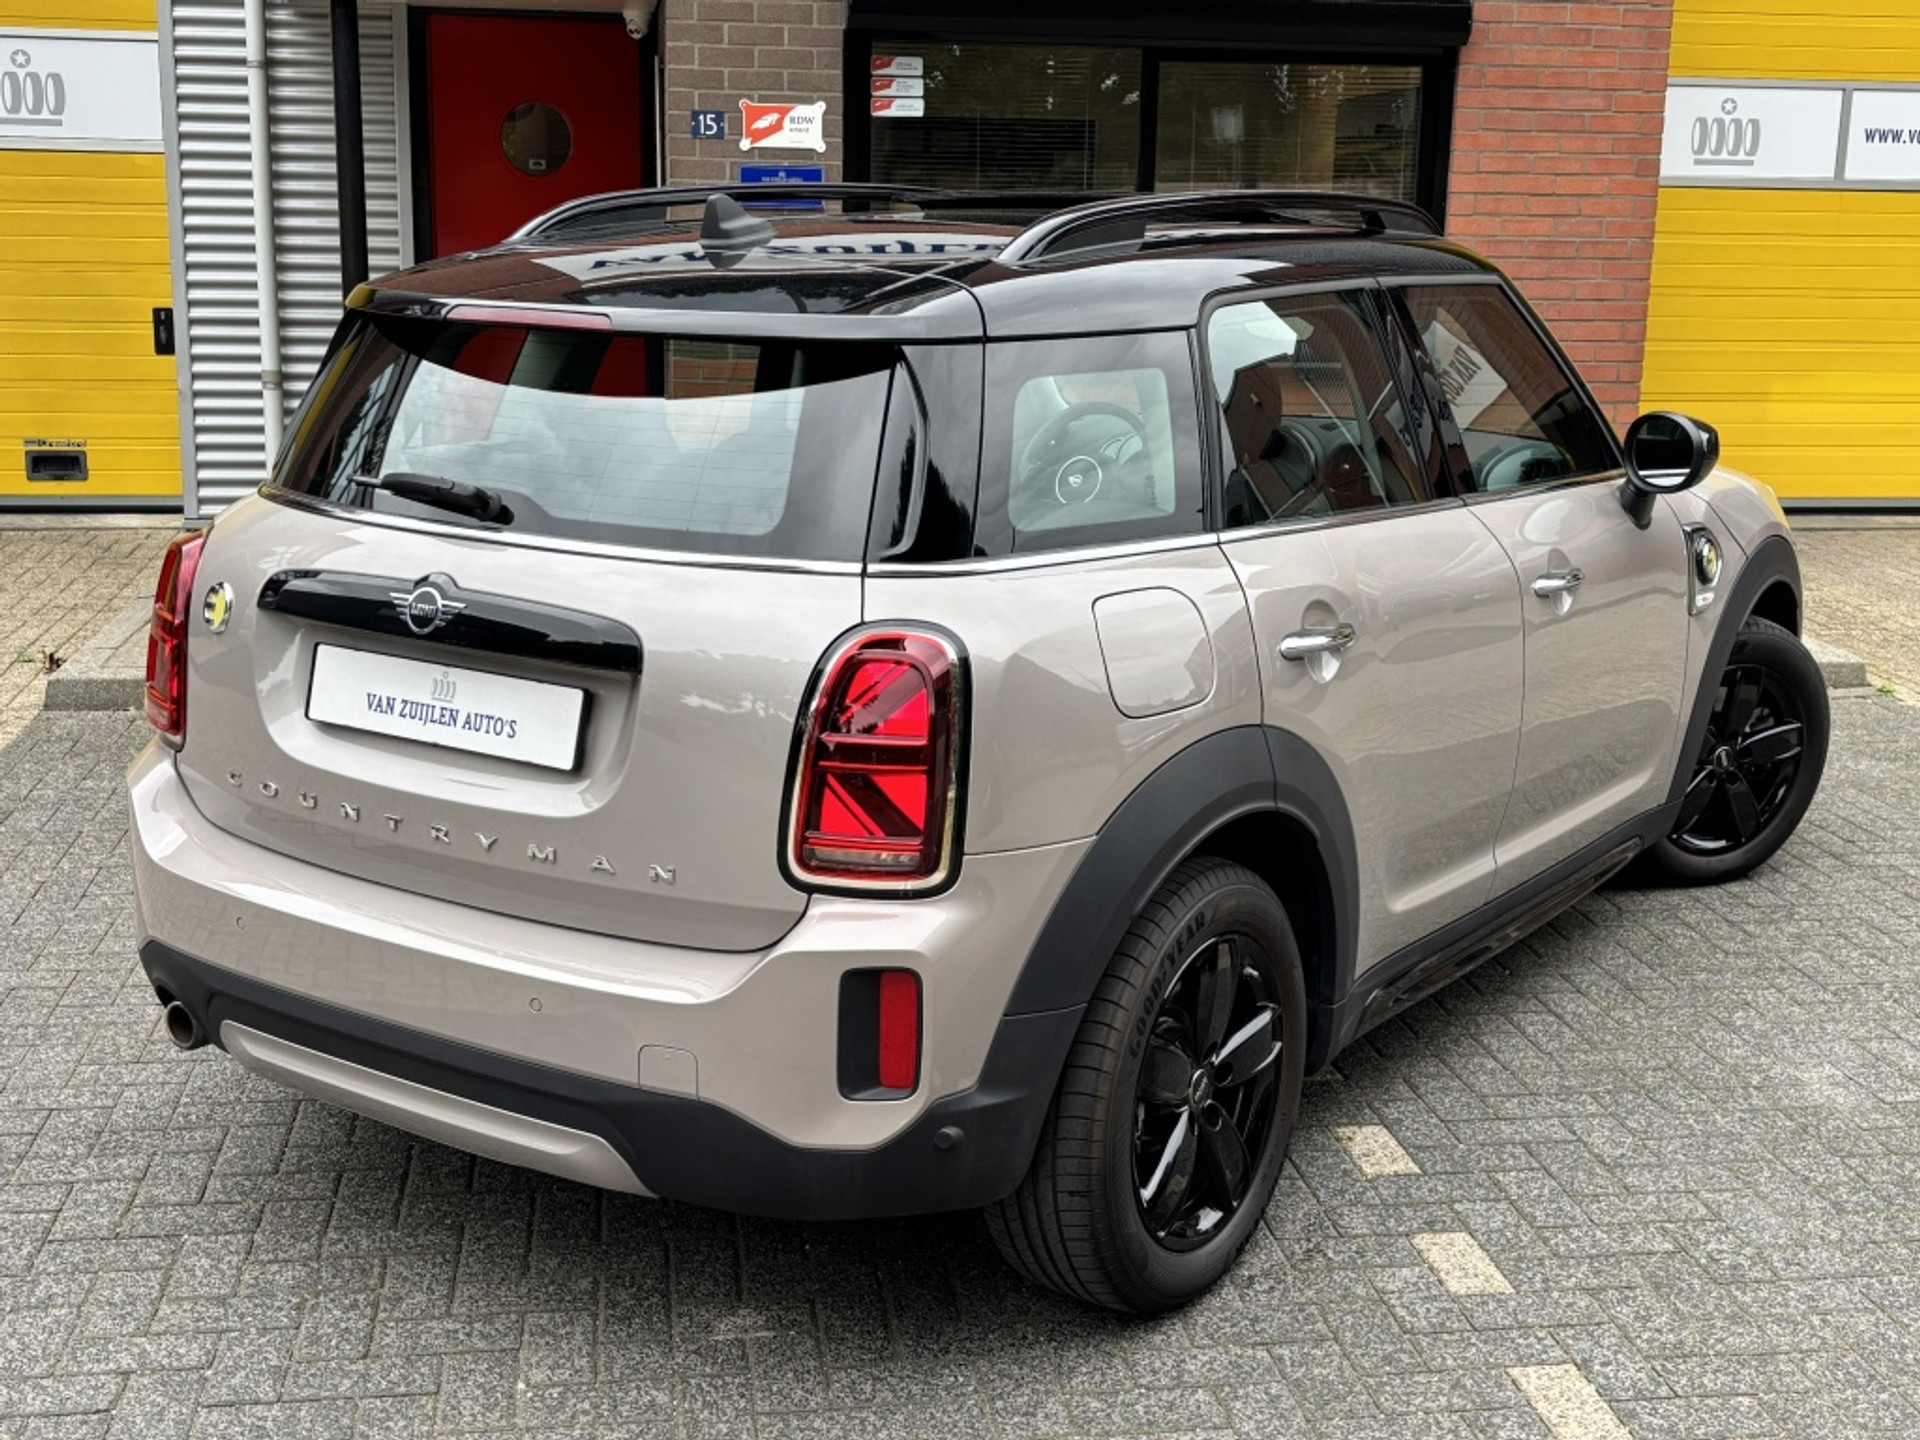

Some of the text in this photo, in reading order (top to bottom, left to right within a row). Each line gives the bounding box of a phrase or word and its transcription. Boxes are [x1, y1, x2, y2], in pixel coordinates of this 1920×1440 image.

[698, 114, 717, 134] 15
[789, 116, 815, 125] RDW
[366, 692, 518, 739] VAN ZUIJLEN AUTO'S
[227, 769, 677, 885] COUNTRYMAN
[1129, 911, 1206, 1059] GOODYEAR
